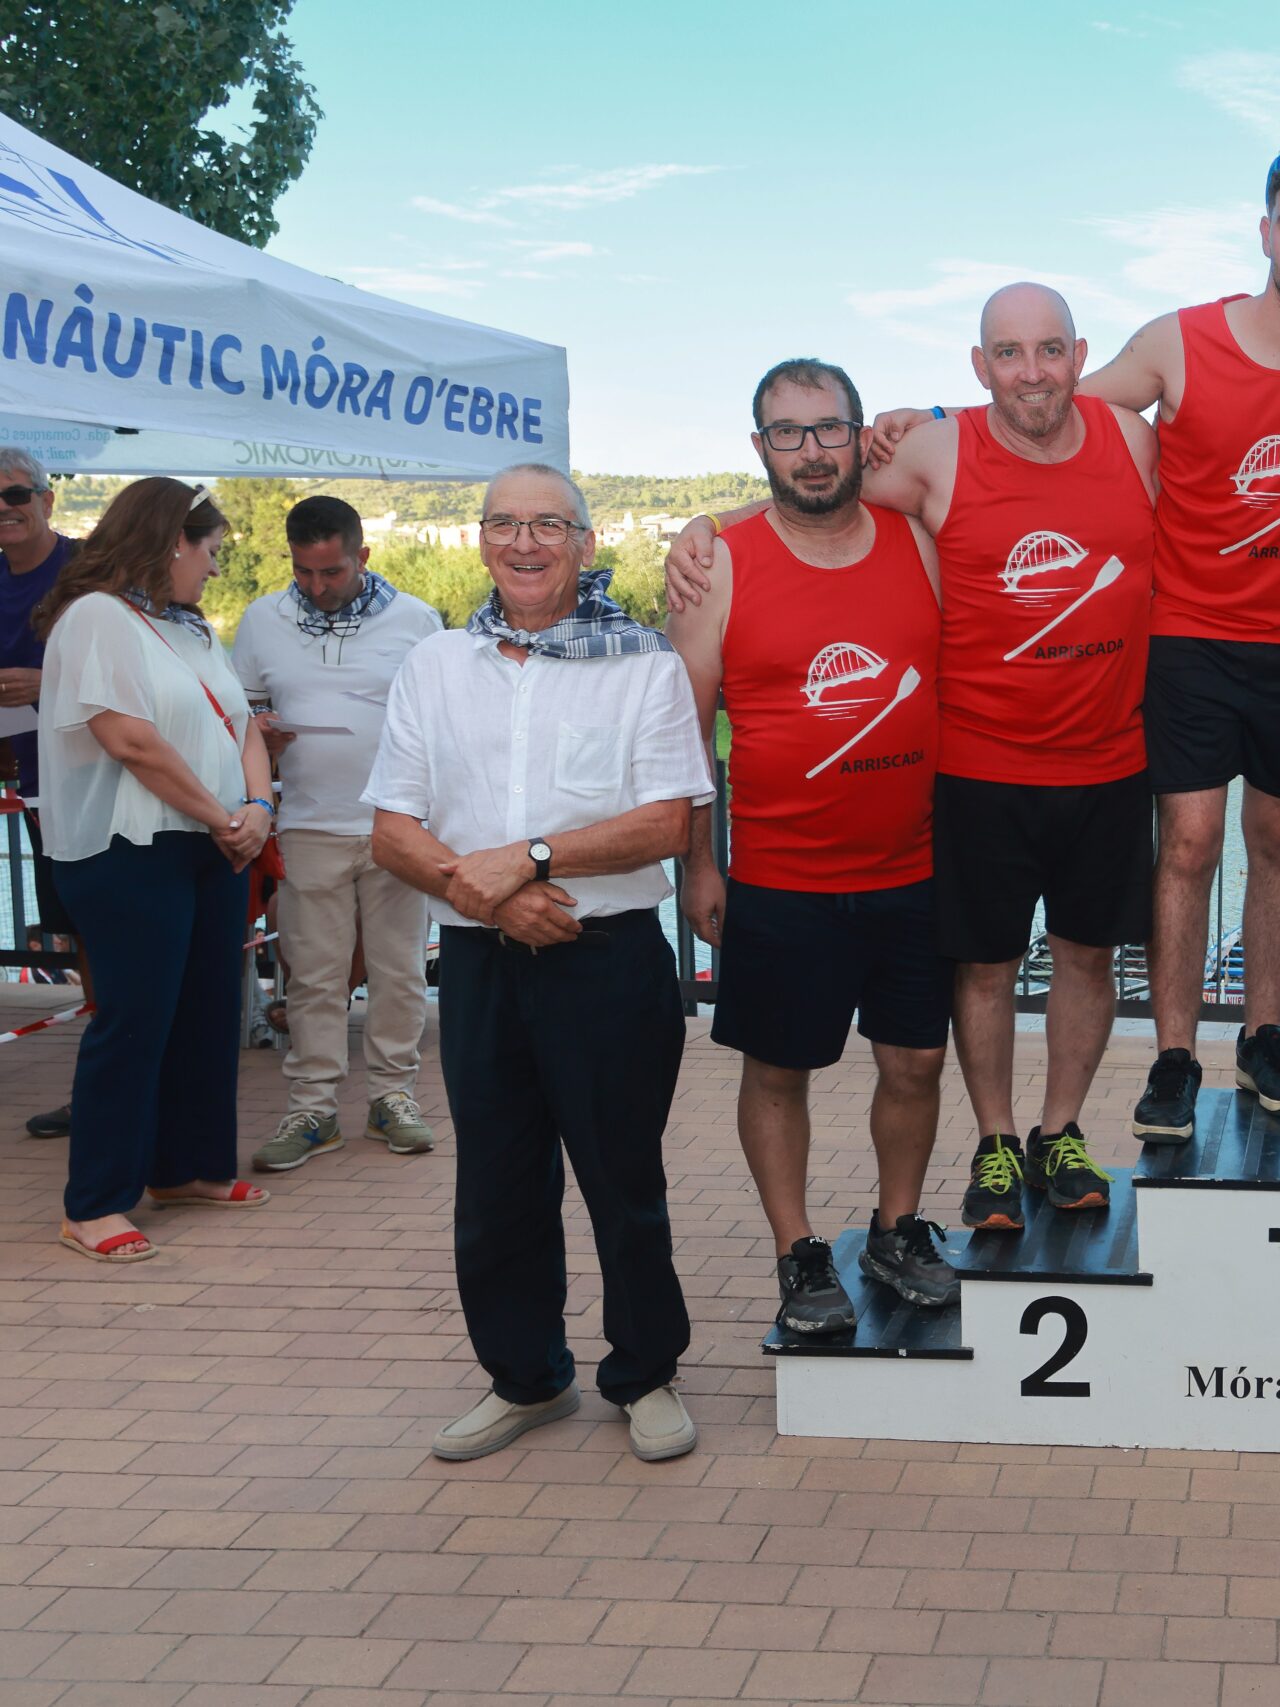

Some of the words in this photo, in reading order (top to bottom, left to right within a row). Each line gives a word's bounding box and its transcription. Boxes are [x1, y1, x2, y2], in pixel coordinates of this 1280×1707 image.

[3, 283, 245, 395] NÀUTIC
[261, 336, 394, 421] MÓRA
[404, 376, 543, 444] D'EBRE
[1034, 638, 1124, 659] ARRISCADA
[1020, 1297, 1090, 1397] 2
